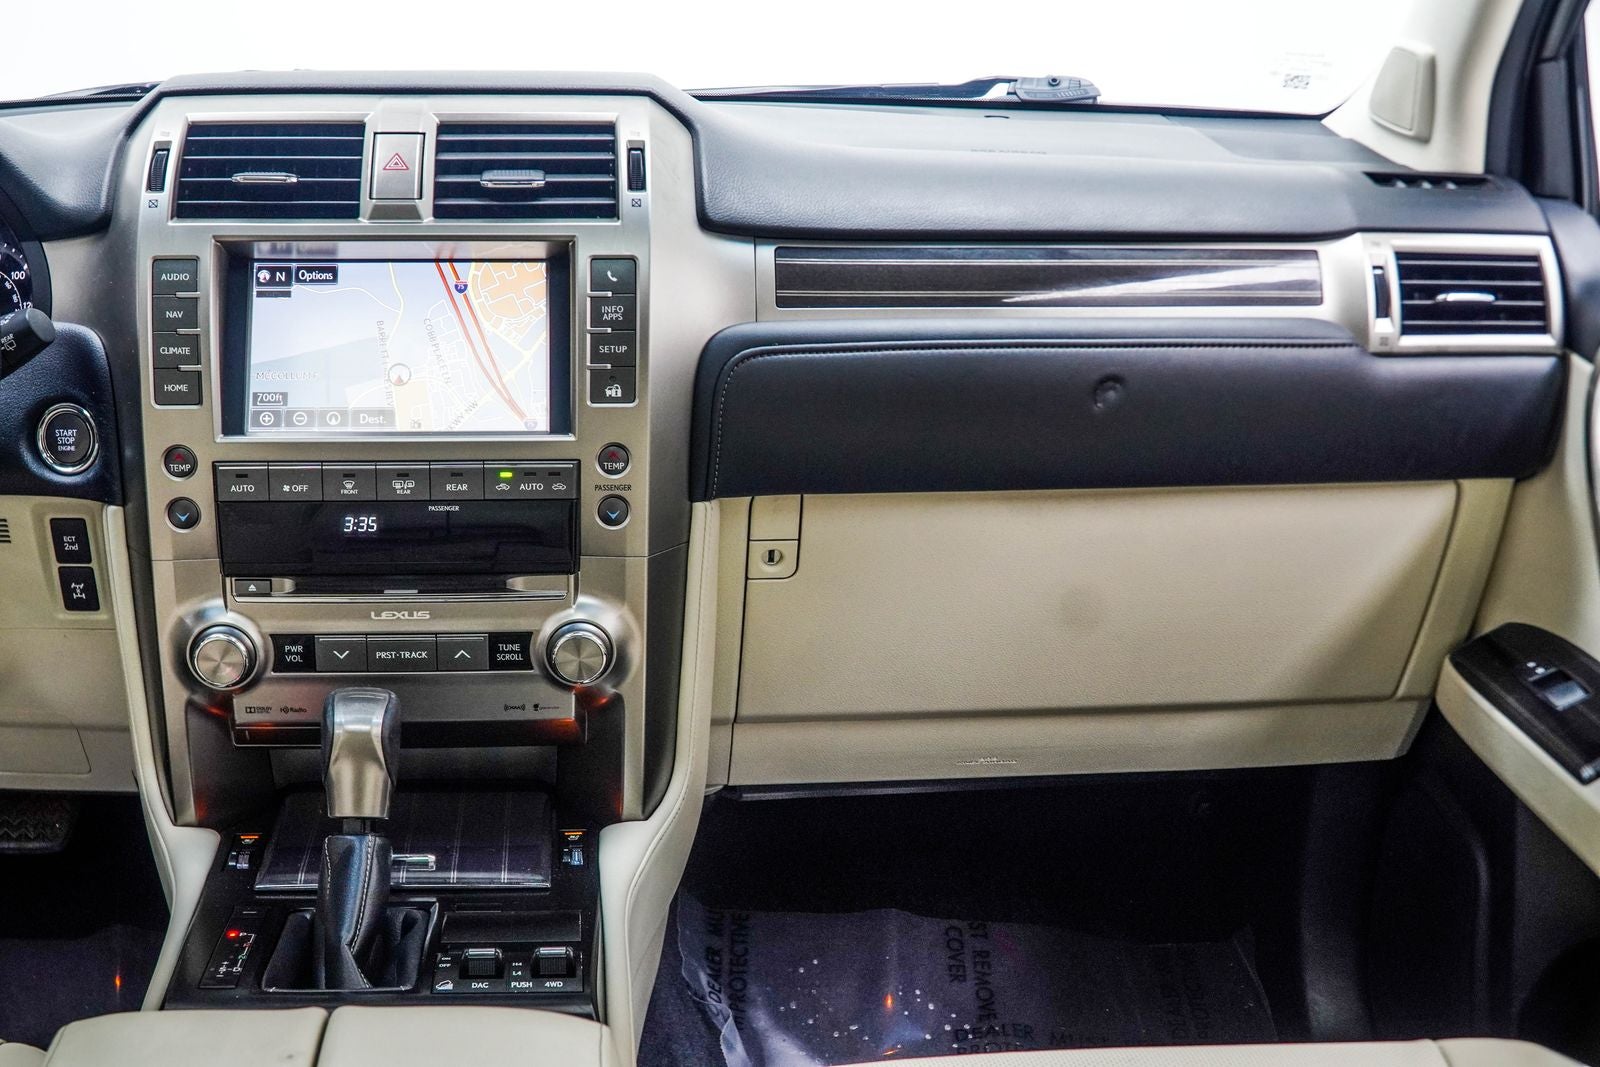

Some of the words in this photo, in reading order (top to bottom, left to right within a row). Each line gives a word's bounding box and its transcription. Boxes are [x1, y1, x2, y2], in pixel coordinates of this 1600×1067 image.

[11, 271, 26, 280] 100
[161, 273, 190, 281] AUDIO
[275, 272, 286, 281] N
[298, 270, 333, 282] Options
[601, 305, 624, 313] INFO
[602, 313, 623, 321] APPS
[0, 333, 14, 343] REAR
[160, 347, 191, 355] CLIMATE
[599, 345, 628, 353] SETUP
[164, 384, 189, 392] HOME
[257, 393, 283, 402] 700ft
[359, 413, 387, 424] Dest.
[55, 429, 77, 437] START
[169, 464, 191, 472] TEMP
[603, 462, 625, 470] TEMP
[230, 484, 255, 492] AUTO
[291, 484, 309, 492] OFF
[446, 483, 468, 491] REAR
[519, 483, 544, 491] AUTO
[594, 484, 632, 492] PASSENGER
[343, 516, 377, 532] 3:35
[63, 543, 79, 551] 2nd
[371, 610, 431, 620] LEXUS
[284, 645, 303, 653] PWR
[498, 643, 521, 651] TUNE
[285, 655, 303, 663] VOL
[496, 653, 523, 661] SCROLL
[945, 925, 967, 984] COVER
[729, 912, 749, 1013] PROTECTIVE
[706, 946, 722, 1004] DEALER
[511, 981, 533, 989] PUSH
[972, 948, 999, 1024] REMOVE
[953, 1023, 1035, 1043] DEALER
